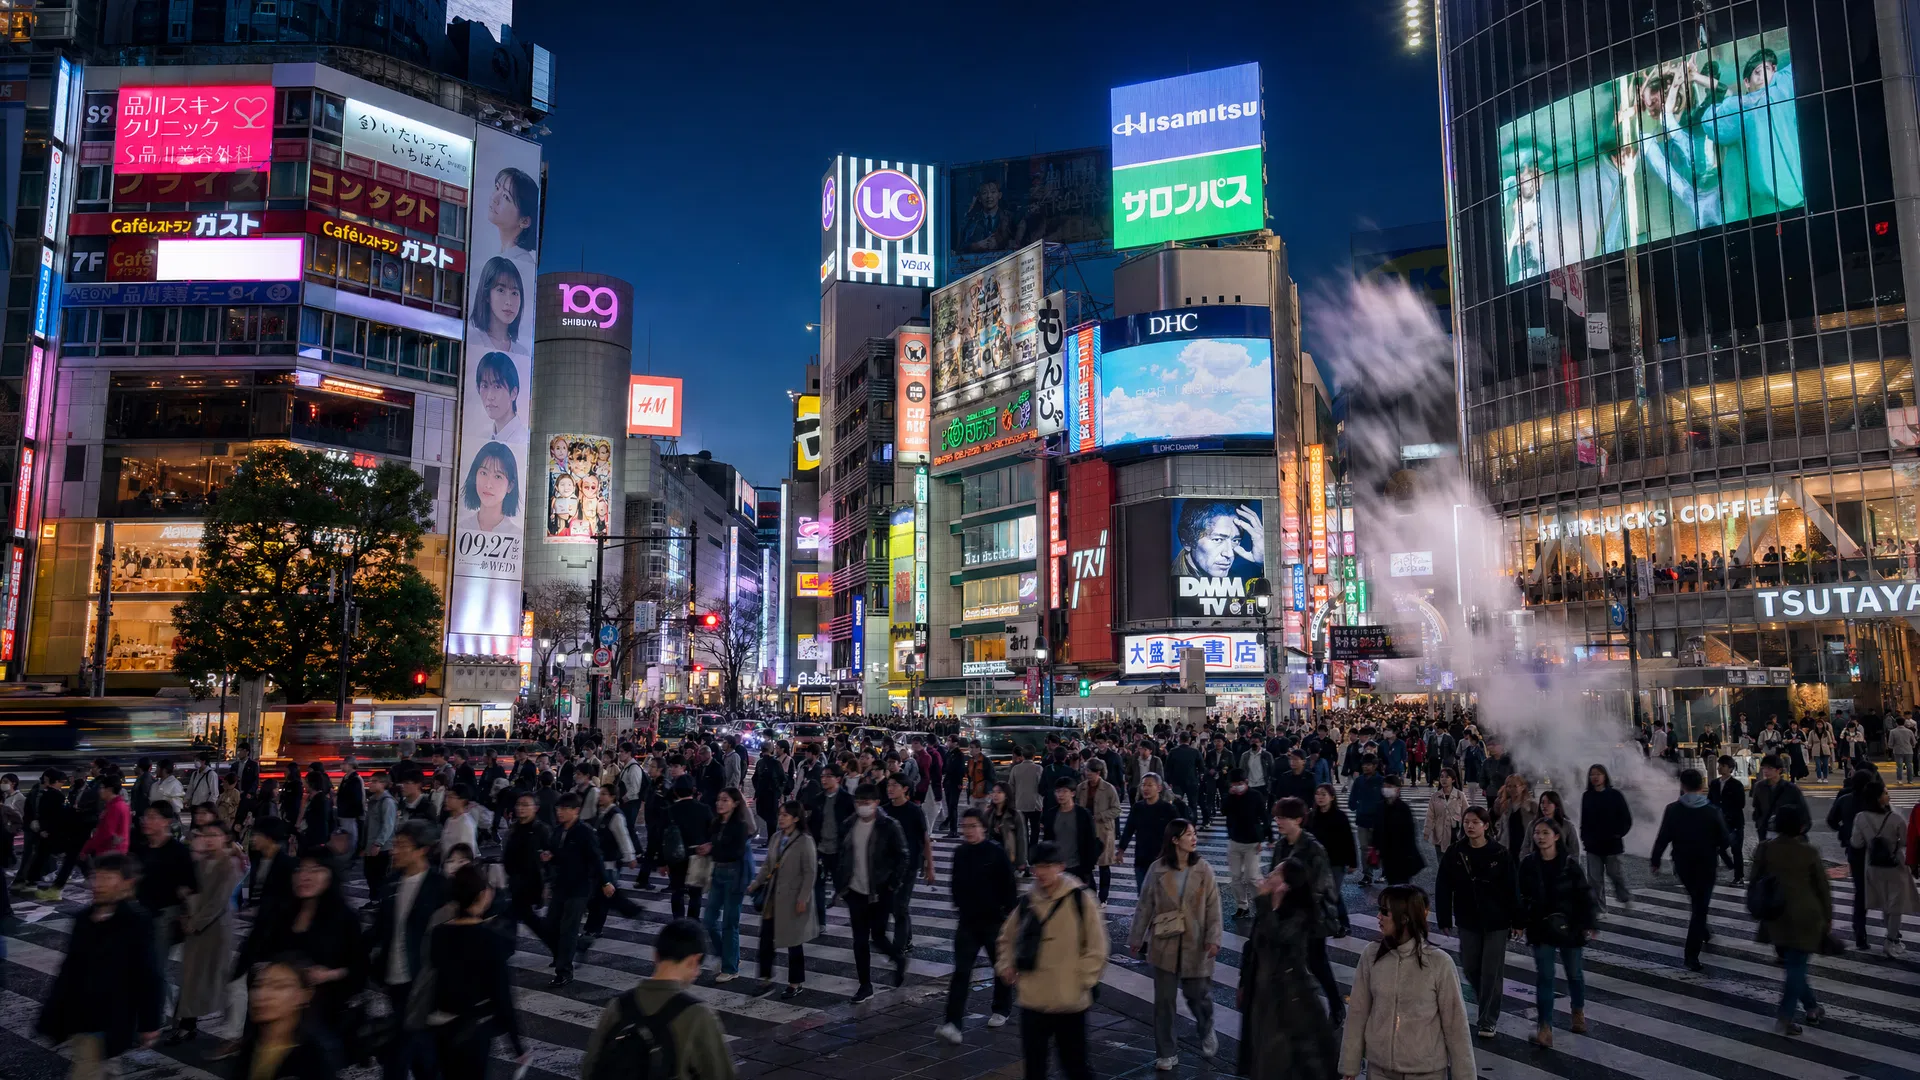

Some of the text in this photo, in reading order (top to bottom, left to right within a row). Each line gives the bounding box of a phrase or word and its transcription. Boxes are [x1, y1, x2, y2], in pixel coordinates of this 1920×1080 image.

[87, 105, 113, 123] S9
[124, 96, 229, 116] 品川スキン
[124, 118, 219, 138] クリニック
[1112, 101, 1257, 136] Hisamitsu
[311, 169, 436, 223] コンタクト
[862, 186, 919, 222] UC
[1121, 174, 1252, 222] サロンパス
[195, 213, 260, 236] ガスト
[72, 252, 105, 272] 7F
[400, 239, 454, 269] ガスト
[69, 287, 113, 300] AEON
[558, 283, 619, 329] 109
[562, 318, 598, 328] SHIBUYA
[1149, 313, 1198, 335] DHC
[1537, 496, 1779, 542] STARBUCKS COFFEE
[1179, 576, 1245, 597] DMM
[1200, 598, 1228, 616] TV
